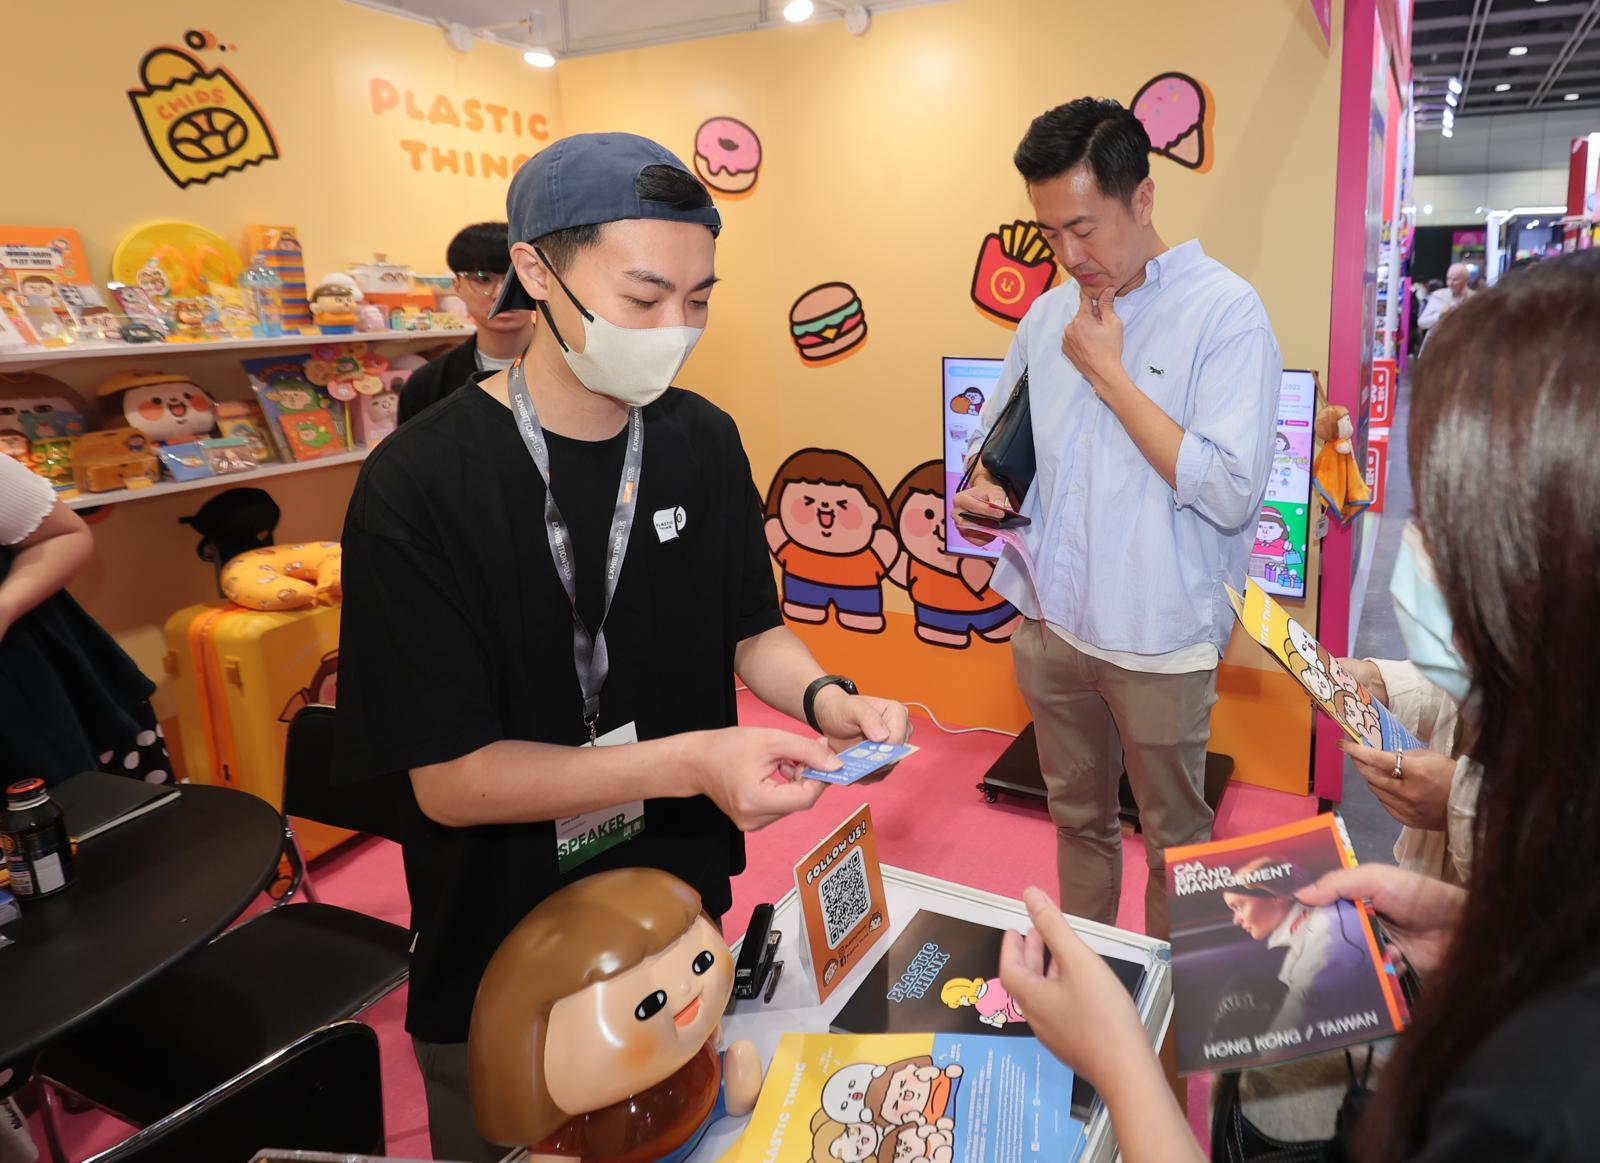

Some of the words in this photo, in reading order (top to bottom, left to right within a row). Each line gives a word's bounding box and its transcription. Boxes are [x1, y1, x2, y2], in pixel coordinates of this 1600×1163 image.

[156, 87, 226, 121] CHIPS
[369, 76, 549, 142] PLASTIC
[558, 812, 626, 858] SPEAKER
[805, 838, 847, 886] FOLLOW
[847, 819, 867, 846] US!
[1173, 861, 1206, 876] CAA
[1175, 865, 1232, 886] BRAND
[1175, 863, 1294, 897] MANAGEMENT
[886, 942, 939, 1003] PLASTIC
[1203, 1036, 1252, 1060] HONG
[1254, 1027, 1303, 1051] KONG
[1316, 1009, 1379, 1038] TAIWAN
[783, 1062, 806, 1107] THING
